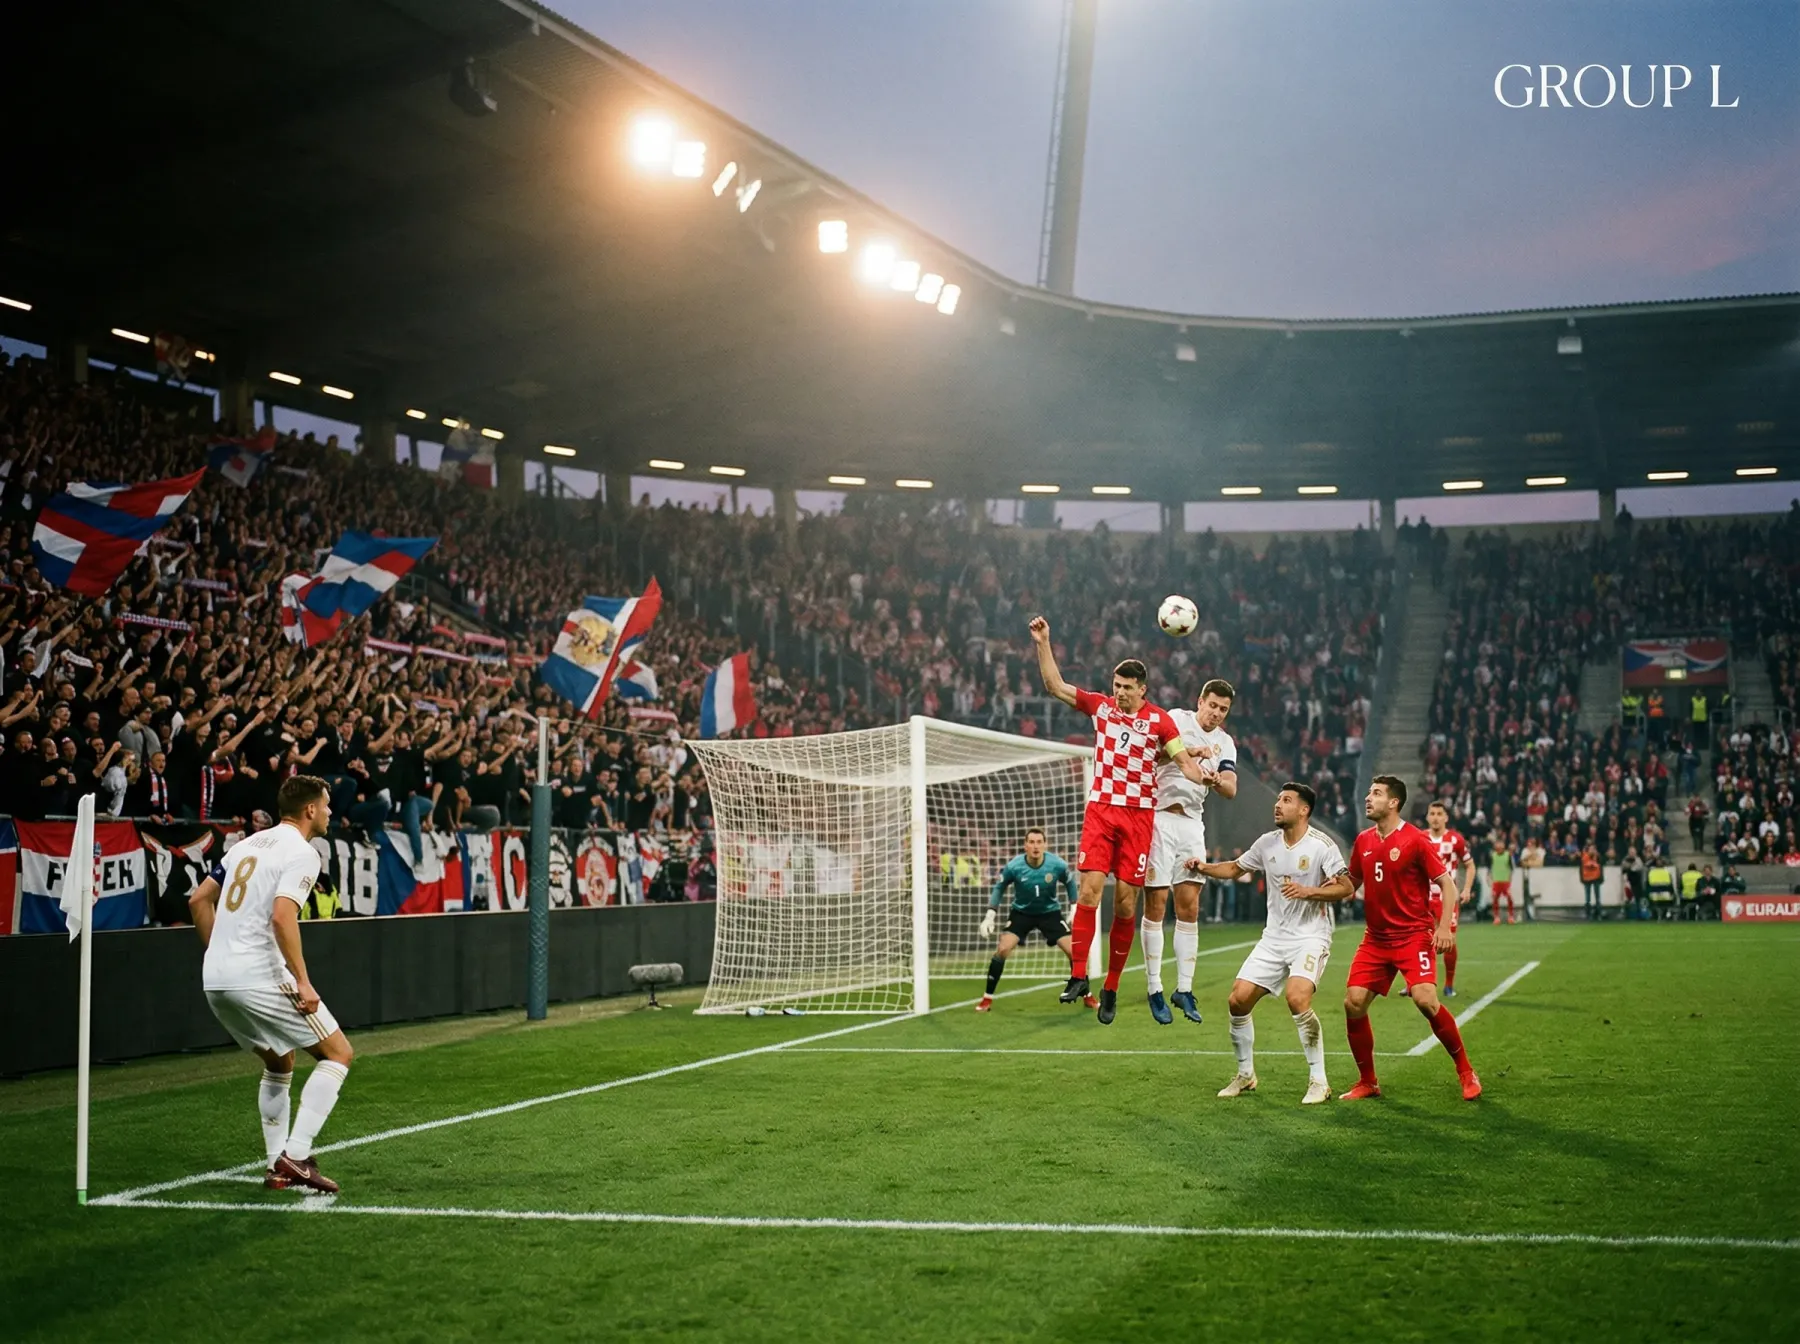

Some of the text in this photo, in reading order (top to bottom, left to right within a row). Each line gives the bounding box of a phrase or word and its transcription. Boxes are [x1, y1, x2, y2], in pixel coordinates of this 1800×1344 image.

[1120, 731, 1130, 749] 9
[1137, 853, 1147, 872] 9
[1374, 862, 1384, 882] 5
[225, 855, 257, 913] 8
[1034, 884, 1040, 897] 1
[1418, 951, 1430, 970] 5
